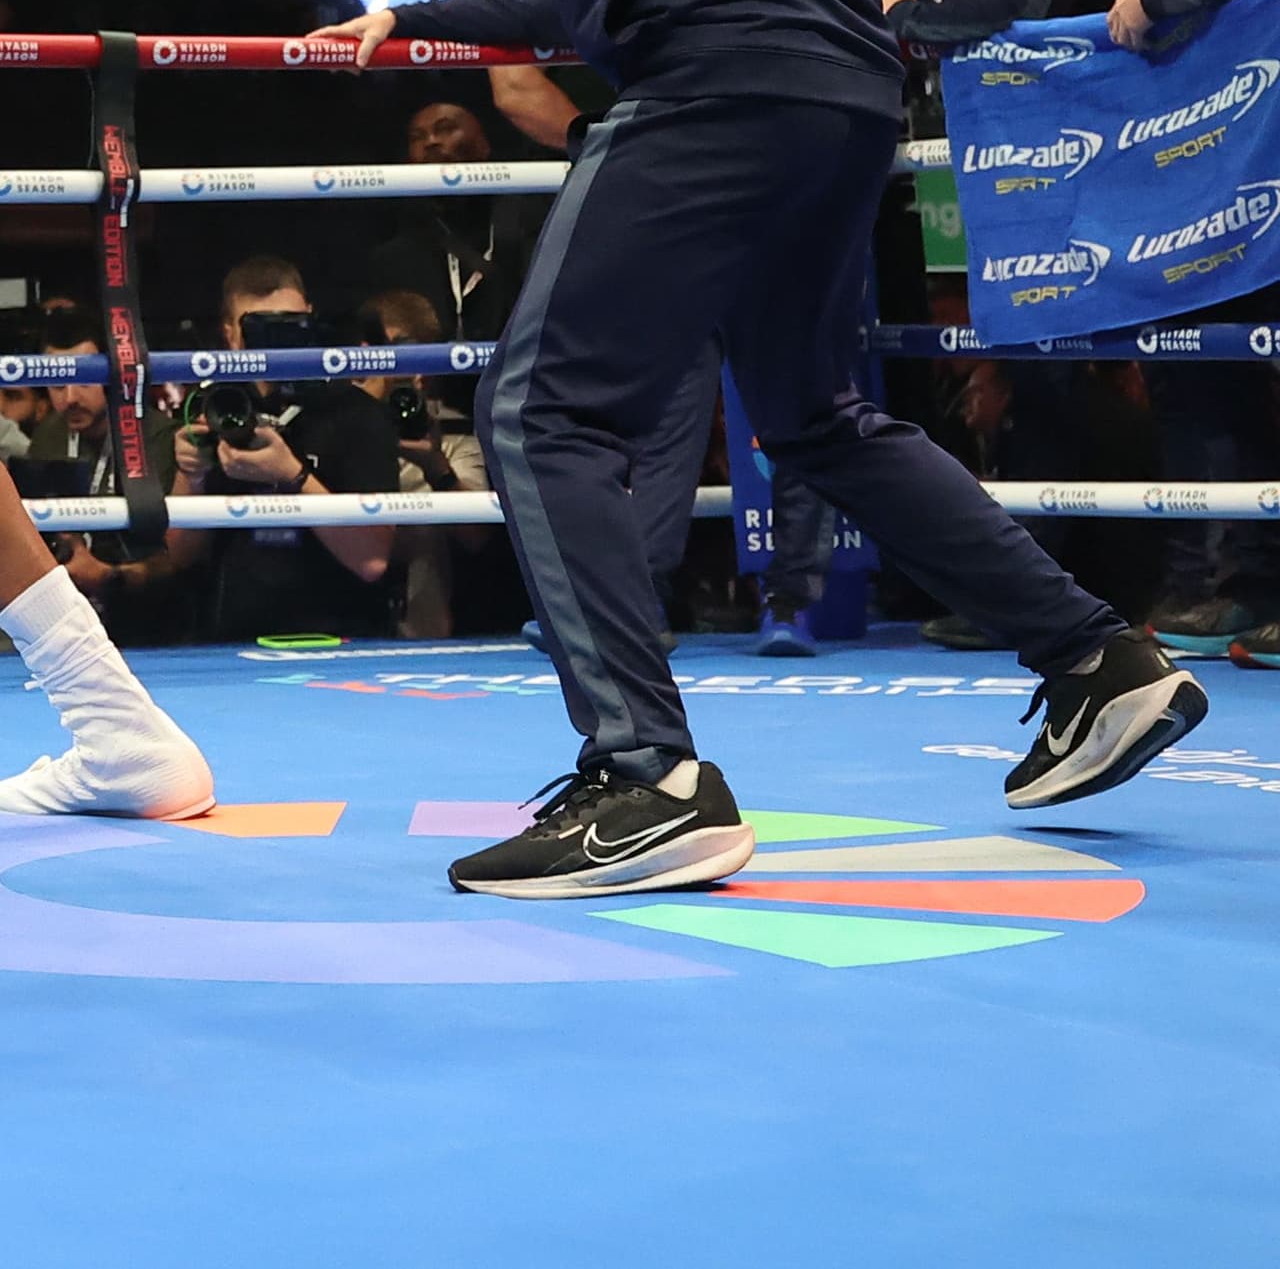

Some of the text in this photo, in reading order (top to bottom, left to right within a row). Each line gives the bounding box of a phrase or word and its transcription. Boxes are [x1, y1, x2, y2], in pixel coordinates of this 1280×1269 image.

[180, 43, 227, 53] RIYADH
[309, 42, 355, 52] RIYADH
[180, 54, 226, 63] SEASON
[309, 53, 355, 63] SEASON
[436, 50, 480, 60] SEASON
[1118, 70, 1253, 150] Lucozade
[1154, 125, 1227, 168] SPORT
[340, 177, 385, 188] SEASON
[467, 172, 511, 182] SEASON
[16, 182, 65, 193] SEASON
[209, 181, 255, 192] SEASON
[1127, 190, 1270, 263] Lucozade
[103, 215, 124, 288] EDITION
[1162, 243, 1247, 284] SPORT
[1159, 329, 1201, 340] RIYADH
[1159, 340, 1201, 352] SEASON
[218, 353, 267, 363] RIYADH
[349, 350, 396, 361] RIYADH
[27, 357, 76, 367] RIYADH
[349, 360, 396, 371] SEASON
[27, 367, 76, 378] SEASON
[219, 363, 266, 373] SEASON
[118, 405, 144, 479] EDITION
[1060, 490, 1097, 500] RIYADH
[1166, 490, 1207, 500] RIYADH
[254, 504, 302, 515] SEASON
[388, 501, 434, 511] SEASON
[1060, 500, 1097, 510] SEASON
[1166, 500, 1208, 511] SEASON
[57, 506, 107, 517] SEASON
